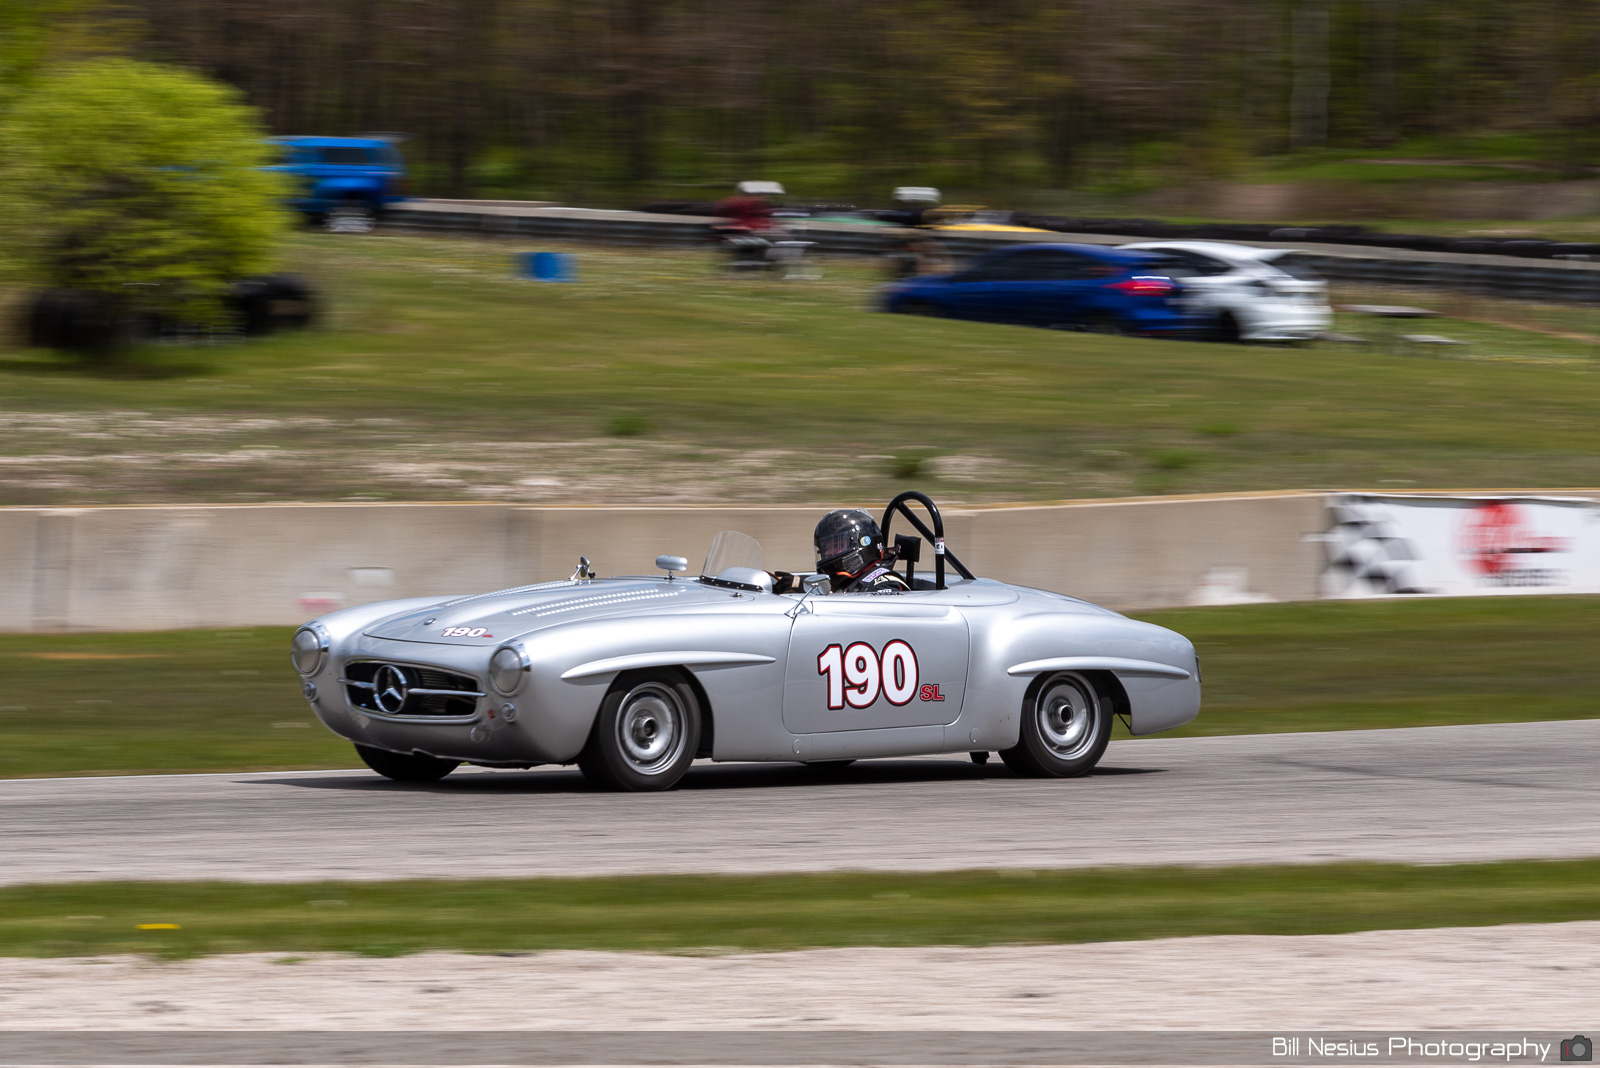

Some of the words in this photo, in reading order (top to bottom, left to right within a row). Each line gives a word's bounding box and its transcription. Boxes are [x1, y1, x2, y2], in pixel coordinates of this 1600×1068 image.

[441, 626, 488, 638] 190
[817, 639, 919, 710] 190
[920, 684, 945, 701] SL
